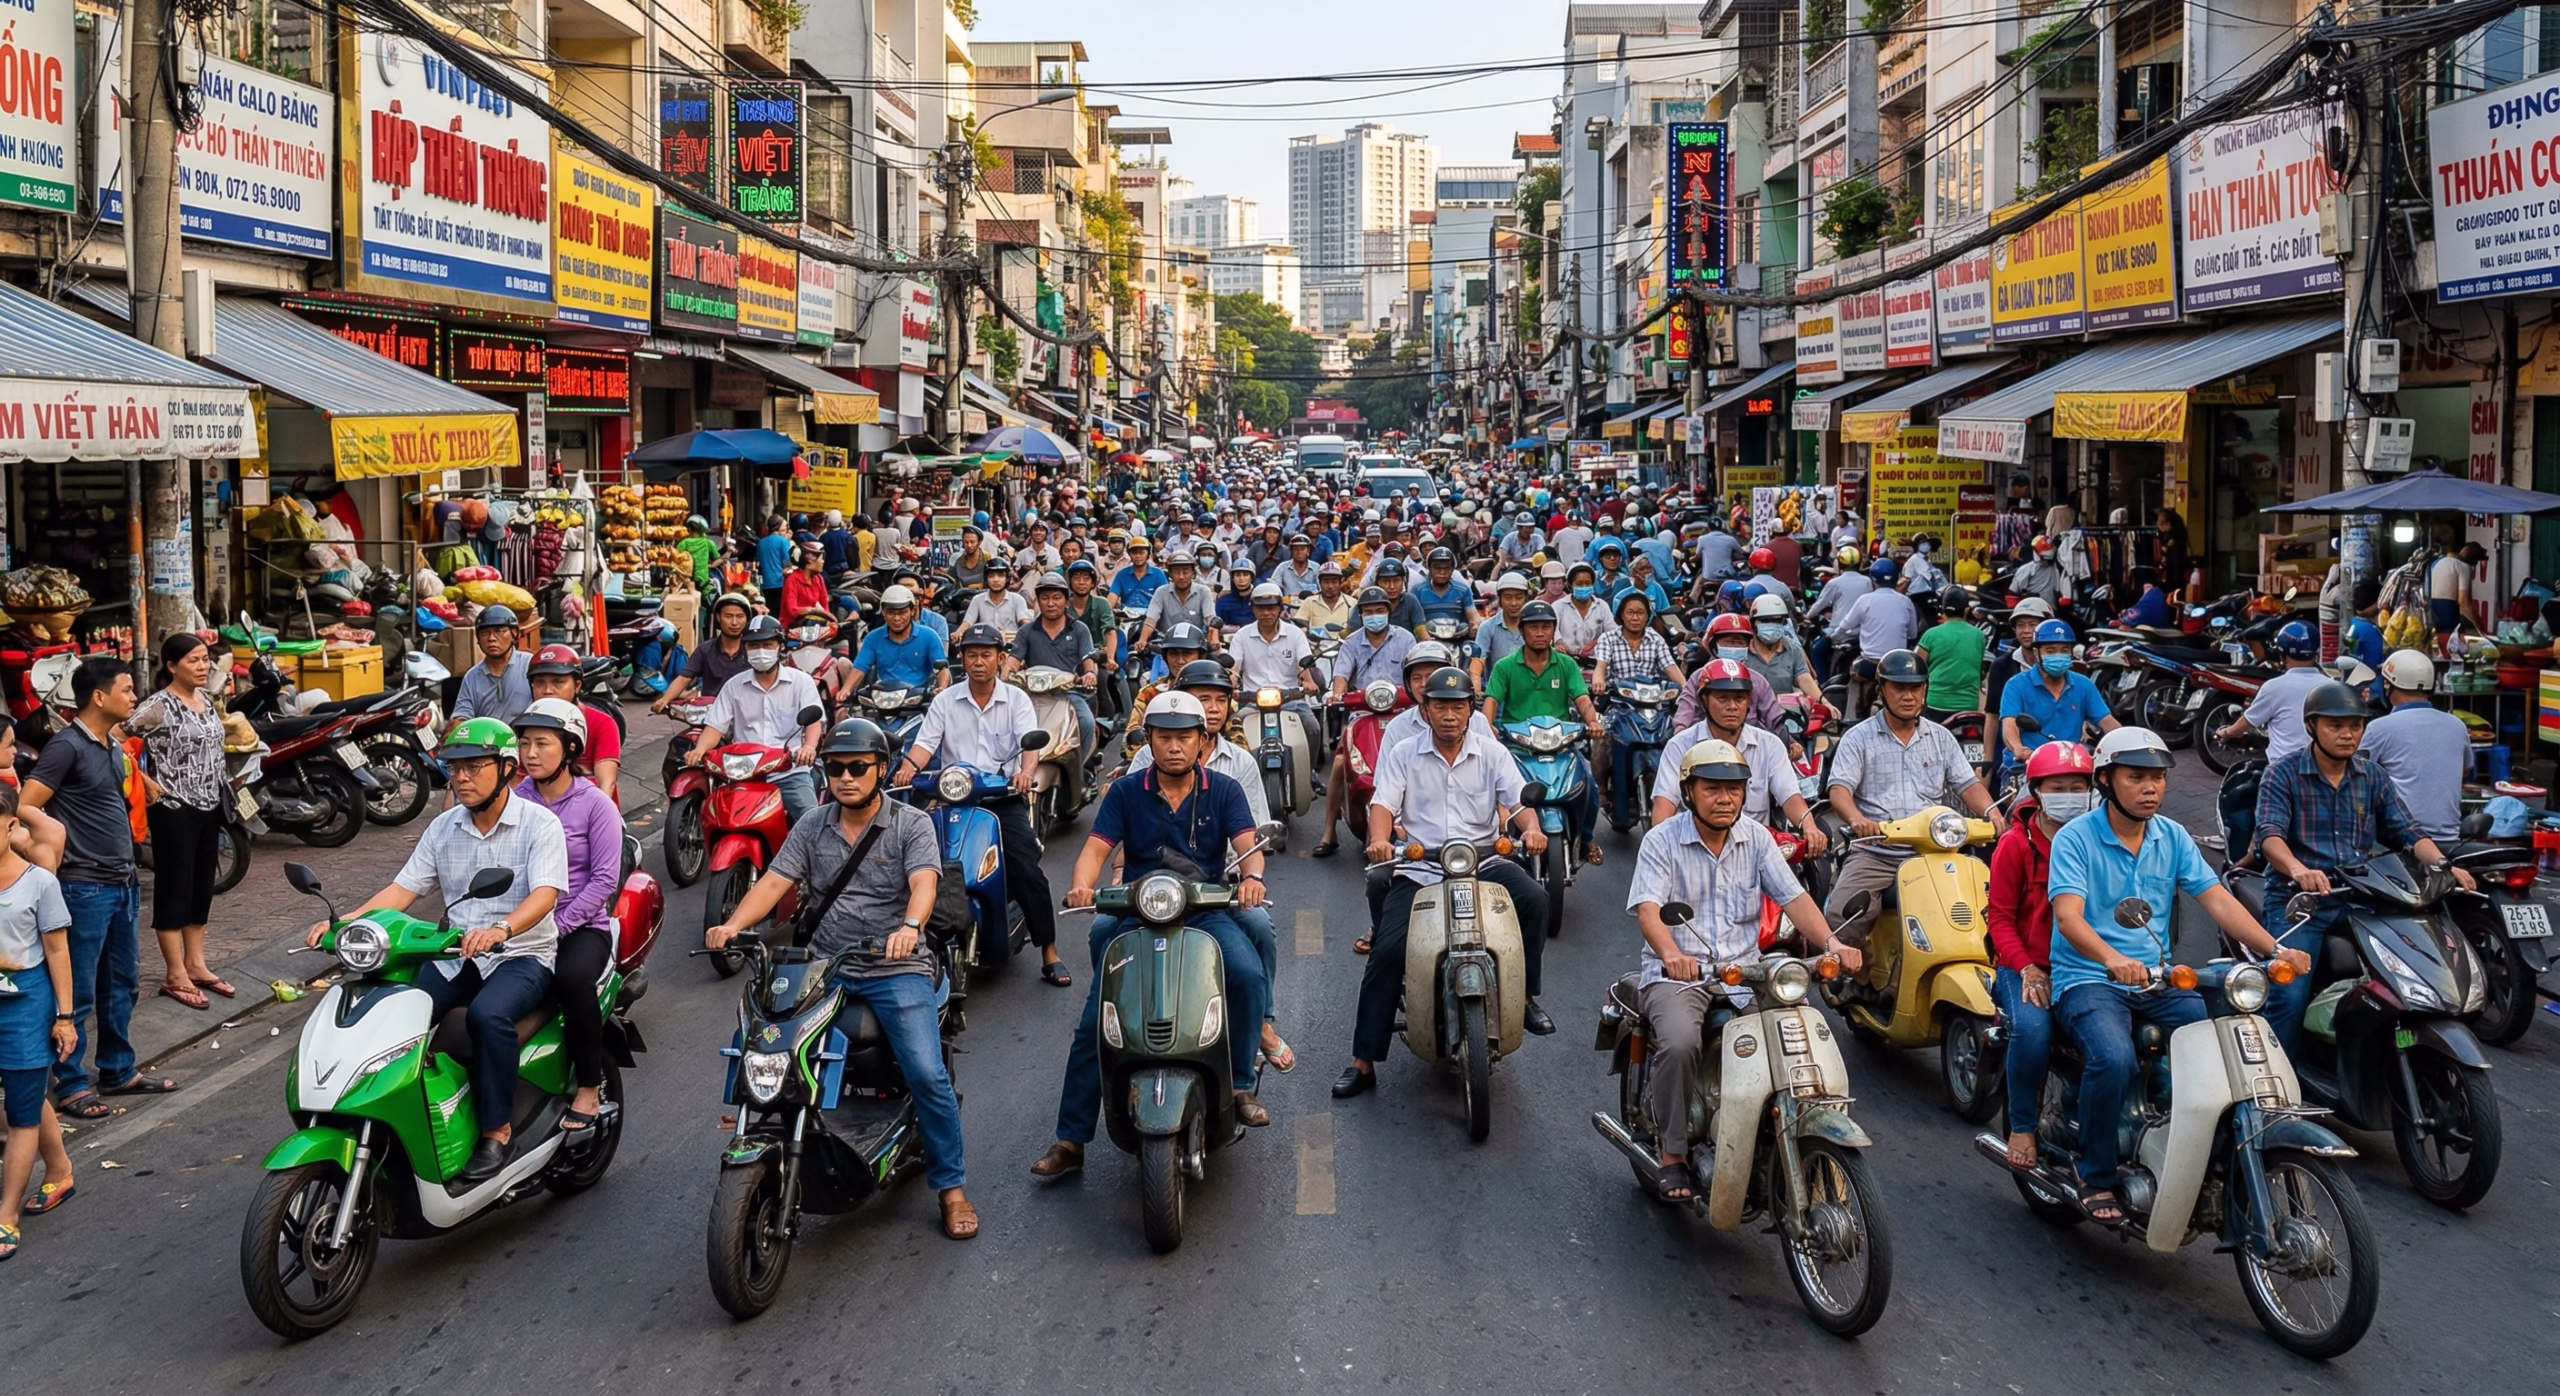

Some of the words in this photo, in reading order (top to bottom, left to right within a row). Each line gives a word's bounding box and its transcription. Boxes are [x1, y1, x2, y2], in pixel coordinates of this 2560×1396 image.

[238, 82, 276, 116] GALO
[206, 113, 227, 157] HÓ
[738, 129, 793, 177] VIỆT
[226, 177, 249, 202] 072
[2439, 138, 2524, 207] THUÁN
[2188, 177, 2222, 242] HÀN
[2523, 202, 2545, 219] TUT
[2270, 235, 2290, 263] CÁC
[107, 397, 160, 439] HÂN
